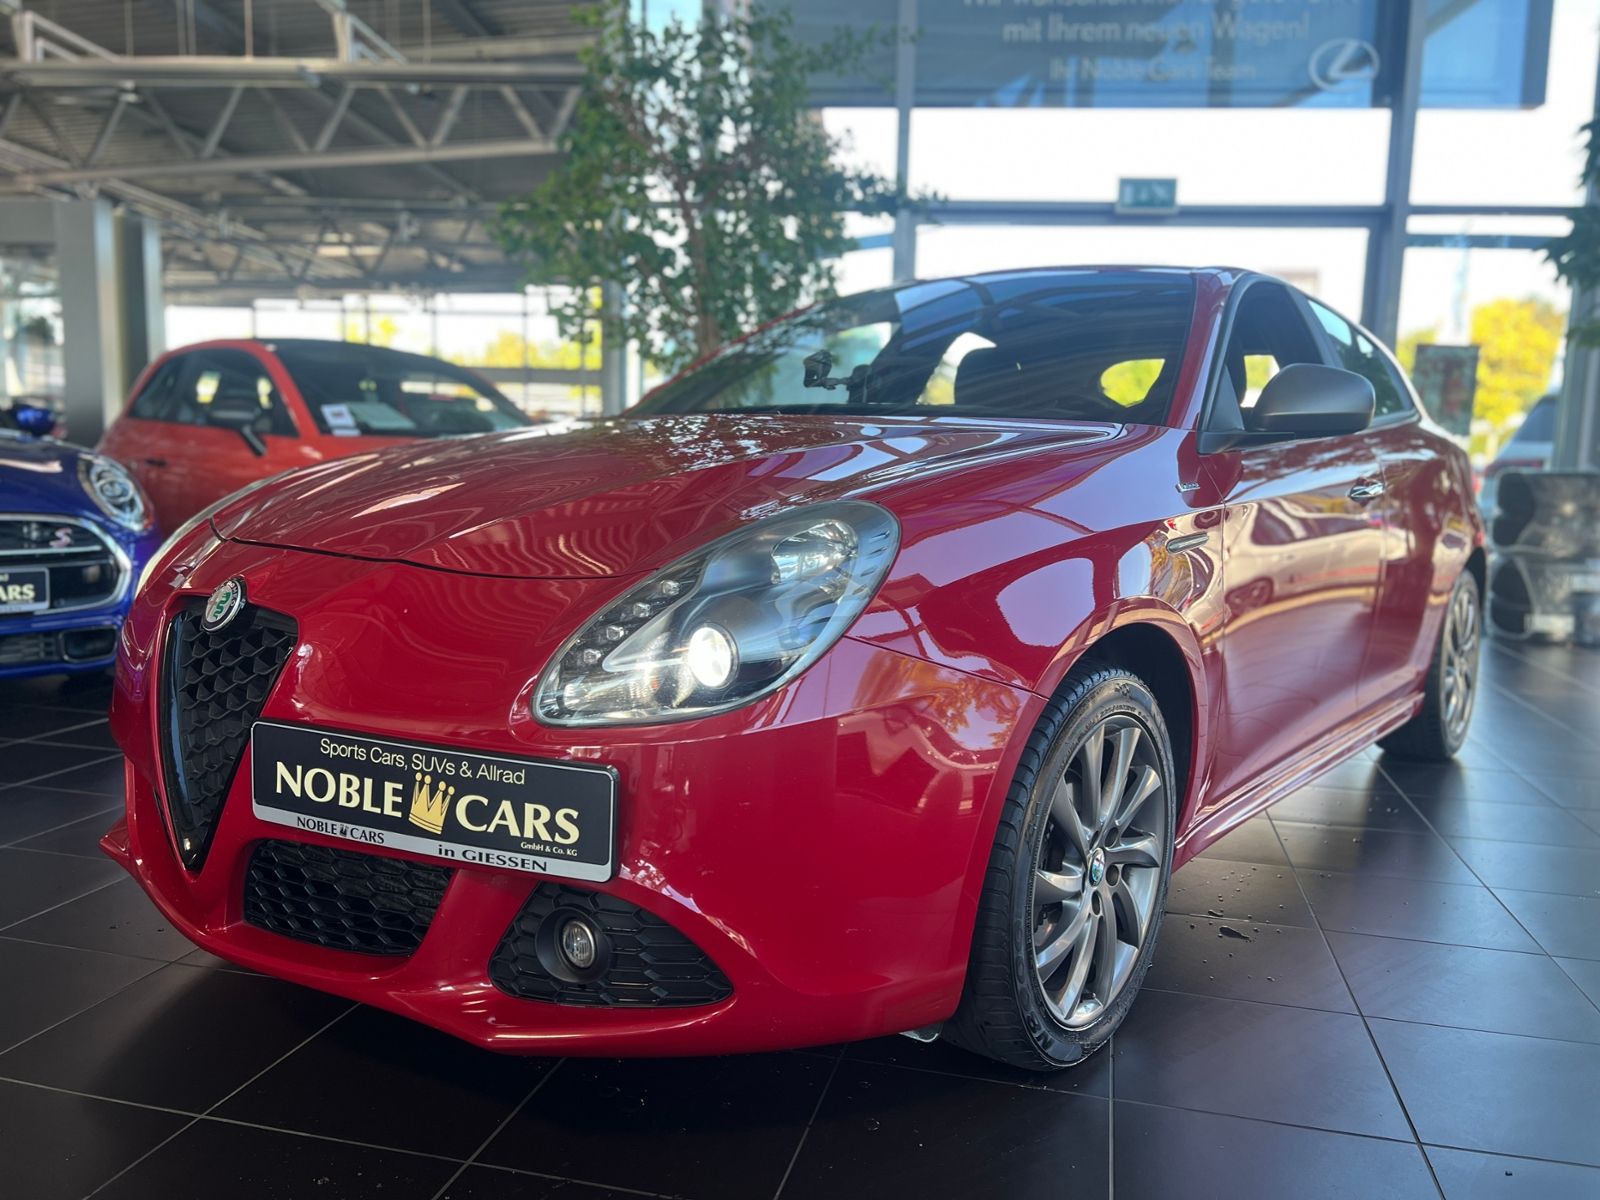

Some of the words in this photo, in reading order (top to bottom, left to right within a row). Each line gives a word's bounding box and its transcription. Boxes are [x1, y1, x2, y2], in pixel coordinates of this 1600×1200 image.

[1003, 17, 1041, 42] mit
[1048, 13, 1121, 42] Ihrem
[320, 738, 366, 761] Sports
[370, 747, 408, 771] Cars,
[411, 753, 456, 776] SUVs
[459, 761, 473, 778] &
[476, 763, 525, 785] Allrad
[275, 761, 403, 818] NOBLE
[455, 794, 580, 845] CARS
[296, 815, 338, 836] NOBLE
[350, 825, 385, 845] CARS
[438, 844, 455, 858] in
[462, 849, 547, 872] GIESSEN
[520, 841, 544, 852] GmbH
[552, 846, 565, 855] Co.
[566, 848, 578, 857] KG
